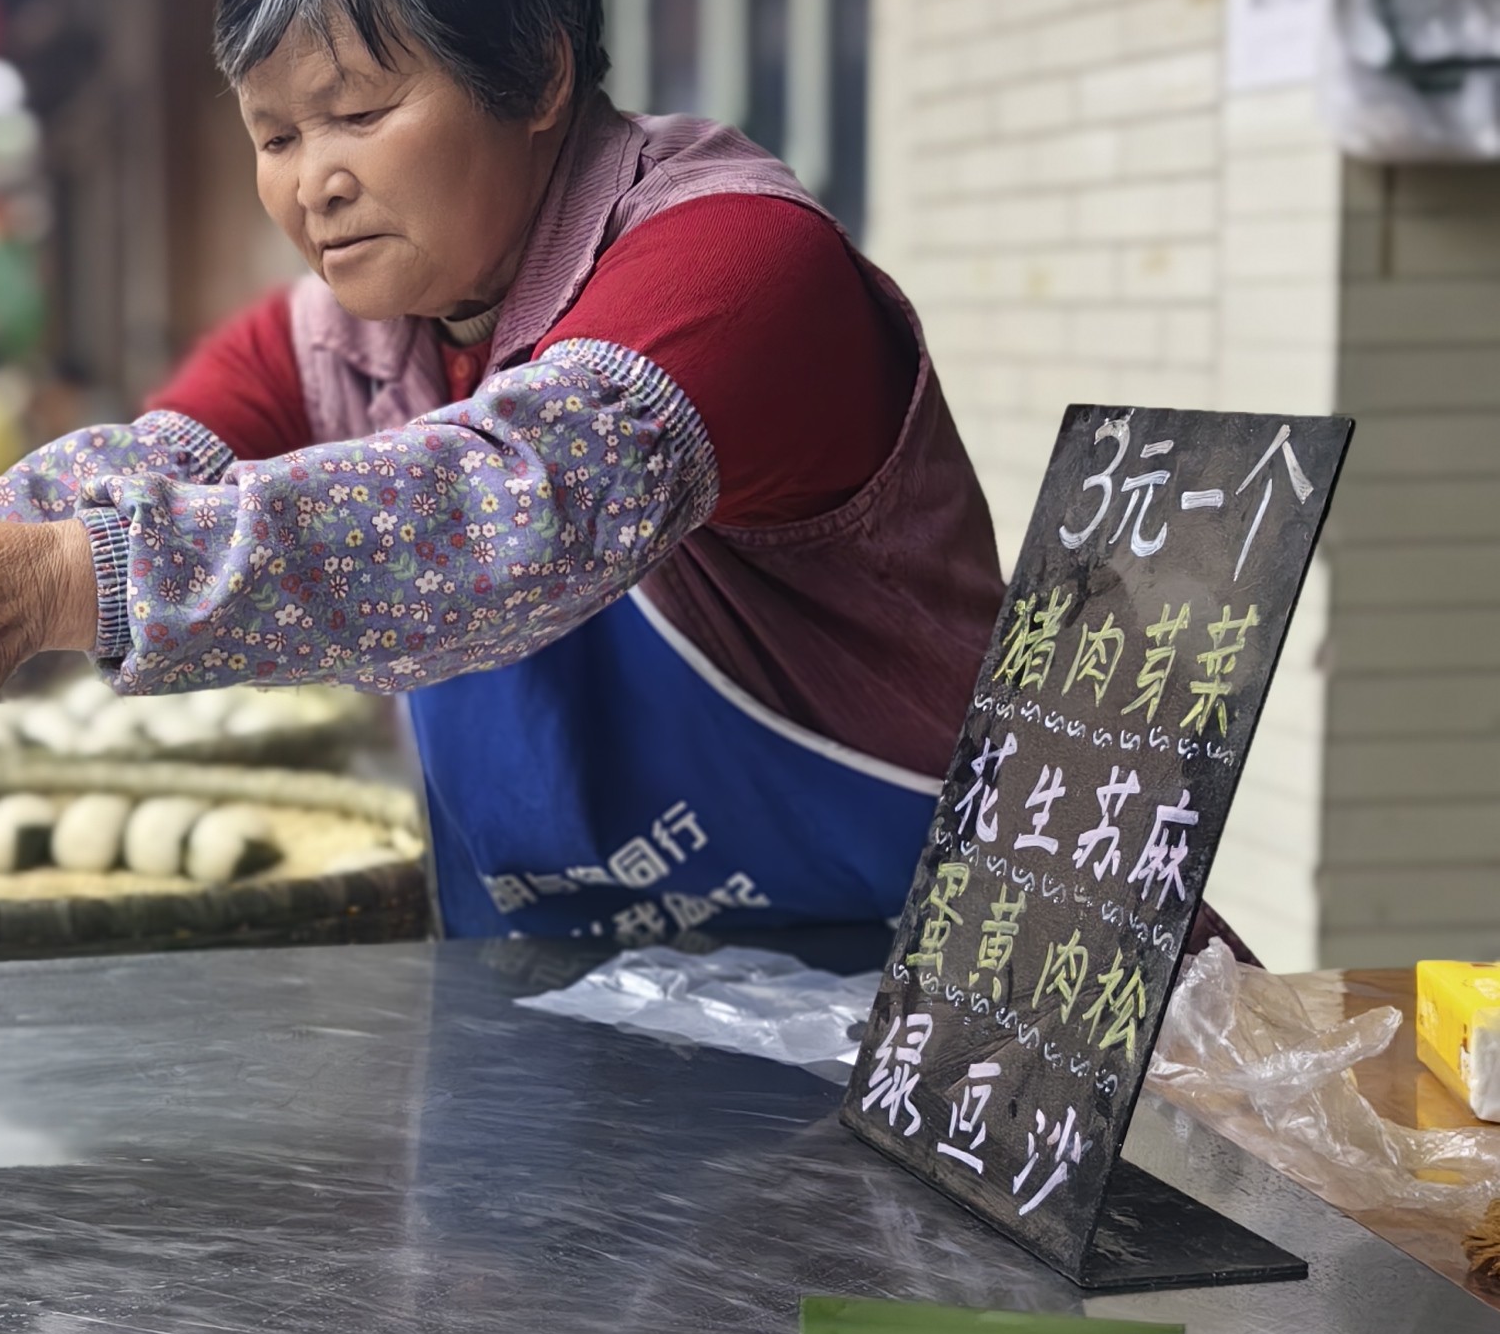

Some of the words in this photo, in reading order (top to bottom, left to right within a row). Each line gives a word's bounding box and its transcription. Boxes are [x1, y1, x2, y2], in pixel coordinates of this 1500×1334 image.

[1058, 416, 1314, 582] 3元一个
[992, 586, 1261, 737] 猪肉芽菜
[955, 732, 1199, 910] 花生苏麻
[906, 862, 1146, 1063] 蛋黄肉松
[861, 1013, 1082, 1217] 绿豆沙
